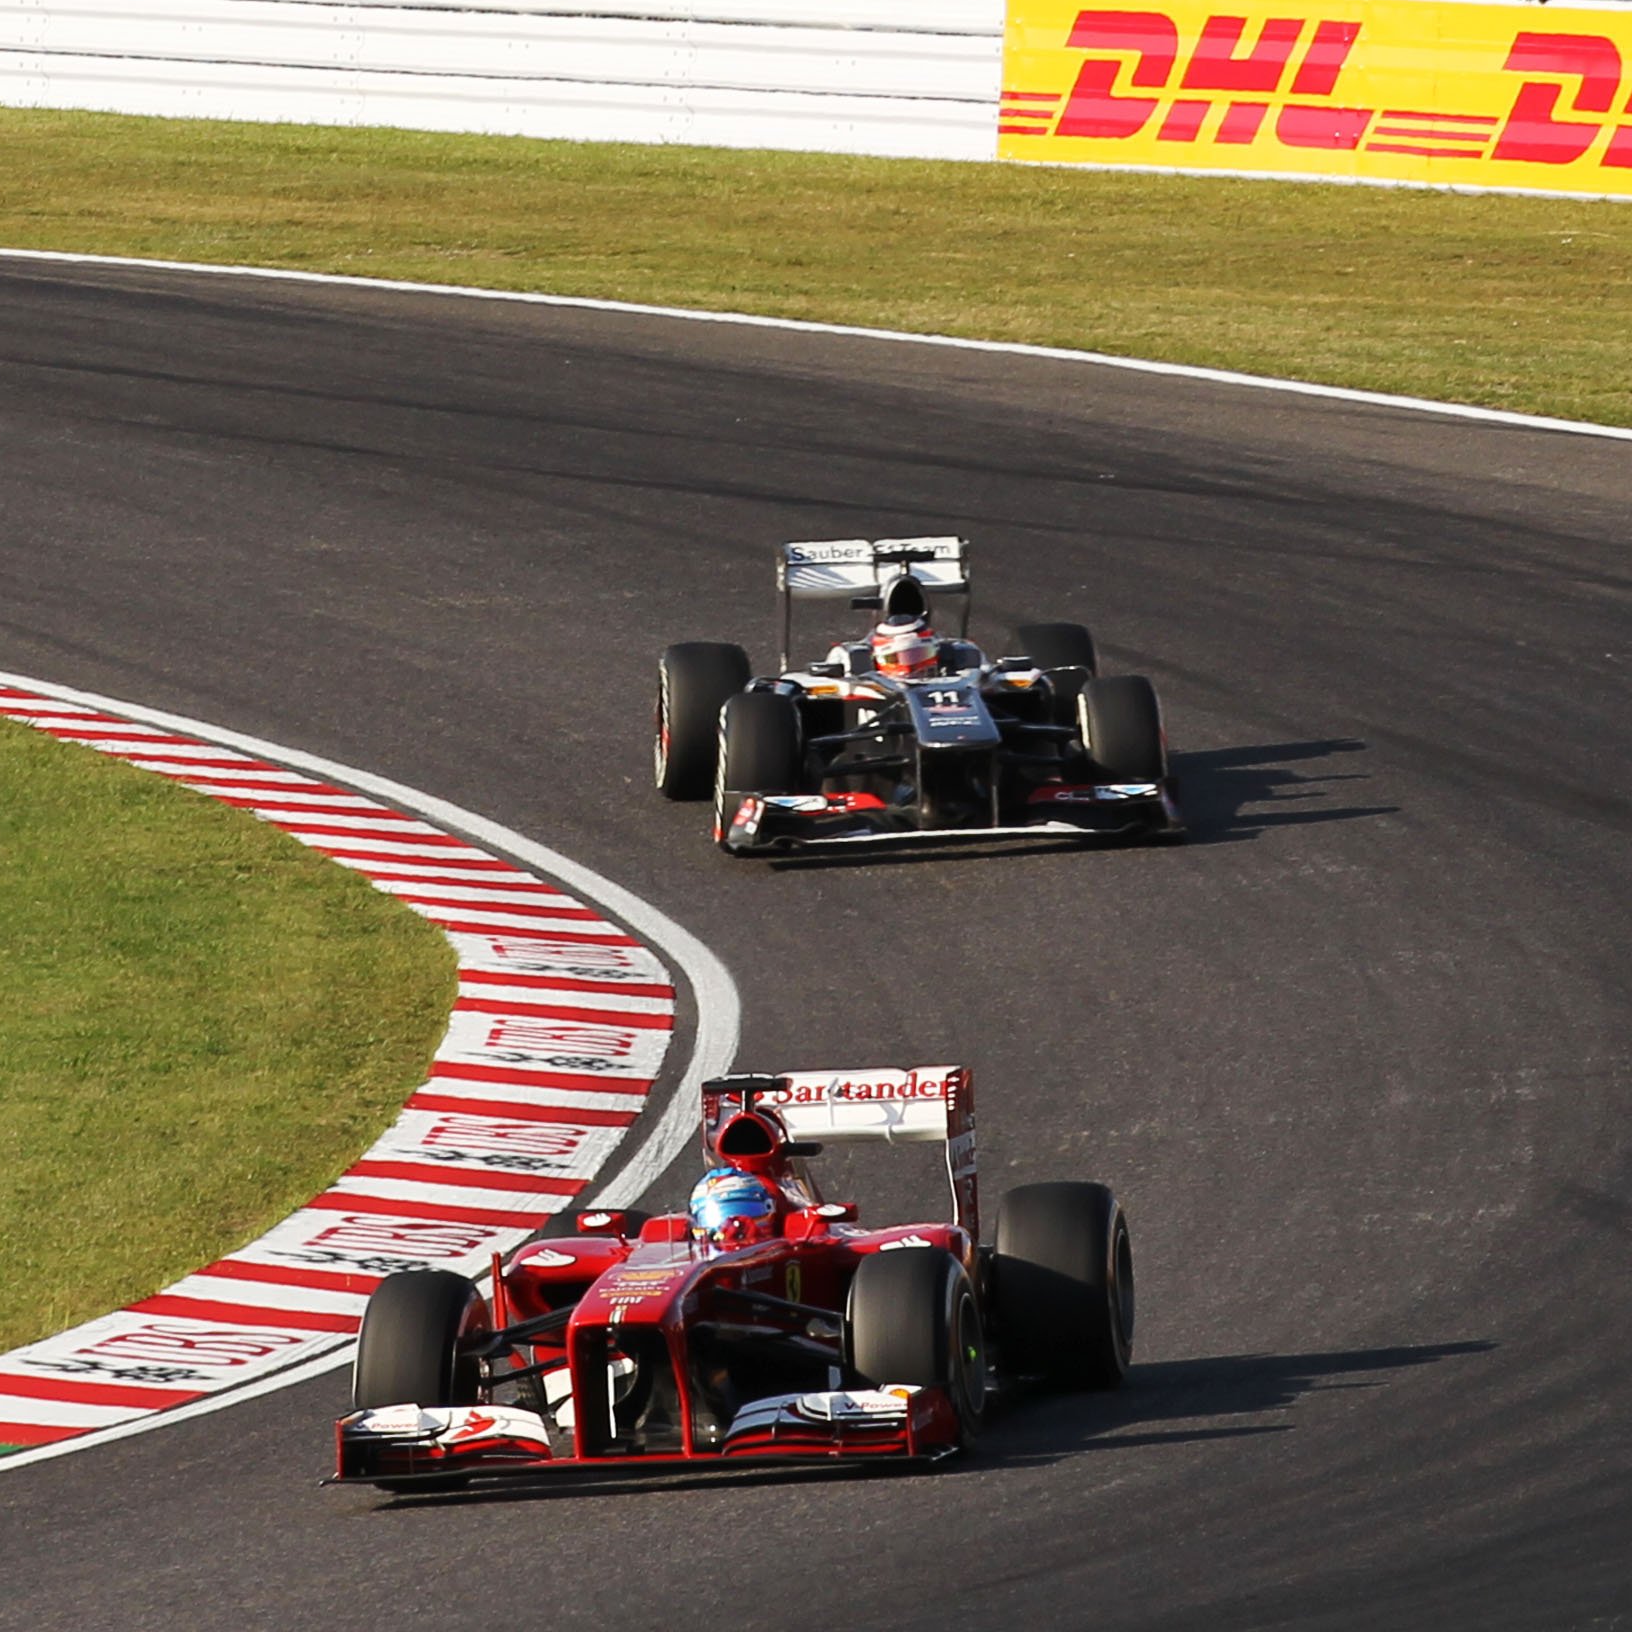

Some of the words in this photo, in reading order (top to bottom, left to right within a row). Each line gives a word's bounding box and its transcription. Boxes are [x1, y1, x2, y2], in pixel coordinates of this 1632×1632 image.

[1054, 10, 1374, 150] DHL
[791, 544, 863, 562] Sauber
[928, 690, 960, 704] 11
[771, 1071, 948, 1104] Santander
